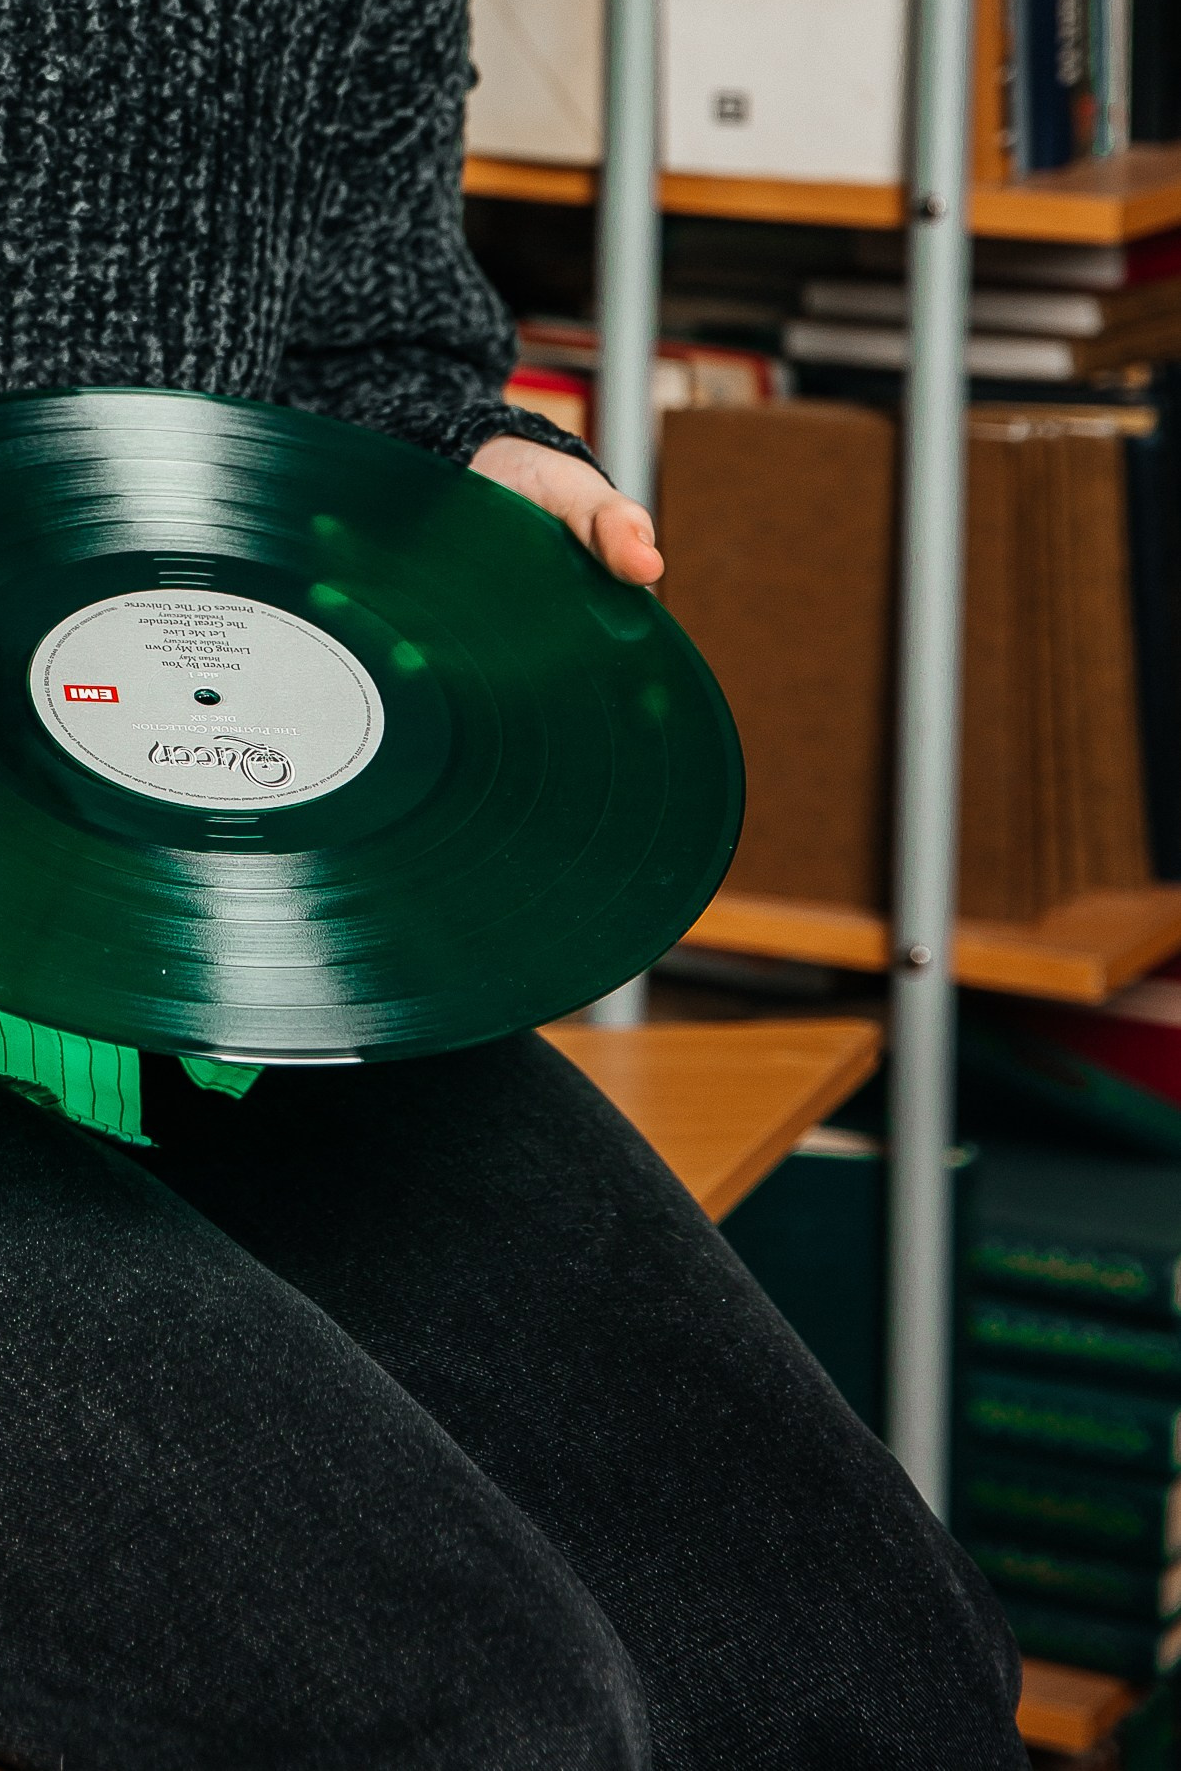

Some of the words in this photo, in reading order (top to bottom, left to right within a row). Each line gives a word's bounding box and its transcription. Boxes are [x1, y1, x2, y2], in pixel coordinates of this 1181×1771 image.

[124, 602, 172, 610] Universe
[199, 604, 212, 612] Of
[215, 605, 254, 613] Princes
[139, 618, 190, 627] Pretender
[145, 644, 172, 652] Own
[175, 644, 192, 652] My
[217, 646, 250, 654] Living
[186, 660, 199, 669] By
[70, 688, 113, 700] EMI
[148, 736, 296, 789] Queen
